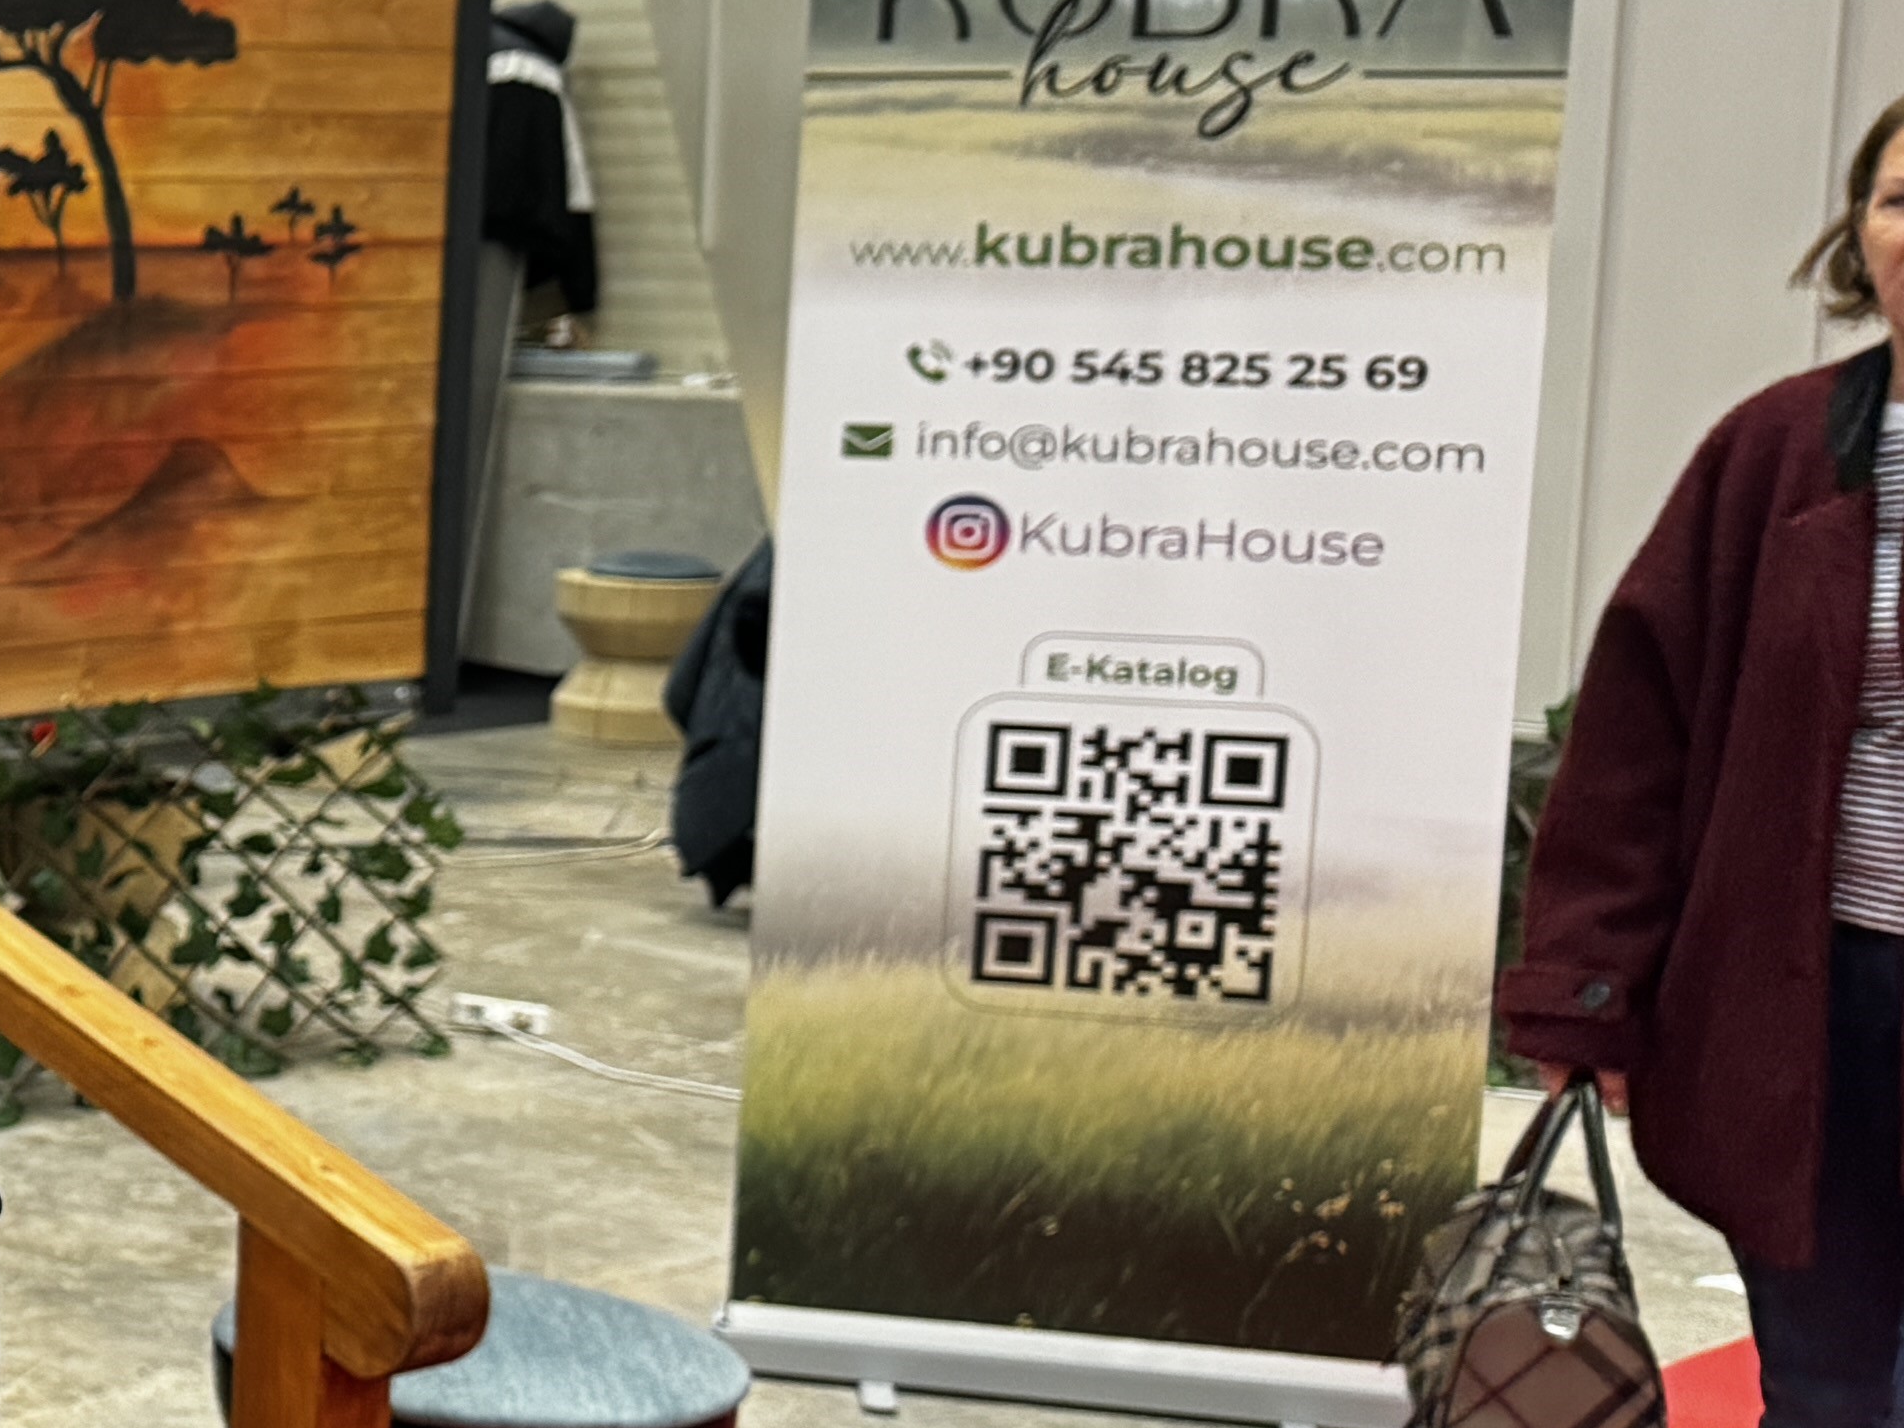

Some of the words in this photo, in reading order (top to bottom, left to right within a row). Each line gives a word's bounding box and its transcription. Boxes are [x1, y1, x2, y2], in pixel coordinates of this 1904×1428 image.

[850, 221, 1506, 273] www.kubrahouse.com
[964, 347, 1056, 385] +90
[1071, 348, 1164, 386] 545
[1180, 350, 1272, 388] 825
[1286, 352, 1348, 390] 25
[1364, 354, 1429, 392] 69
[917, 421, 1484, 473] info@kubrahouse.com
[1019, 512, 1384, 567] KubraHouse
[1046, 651, 1239, 696] E-Katalog
